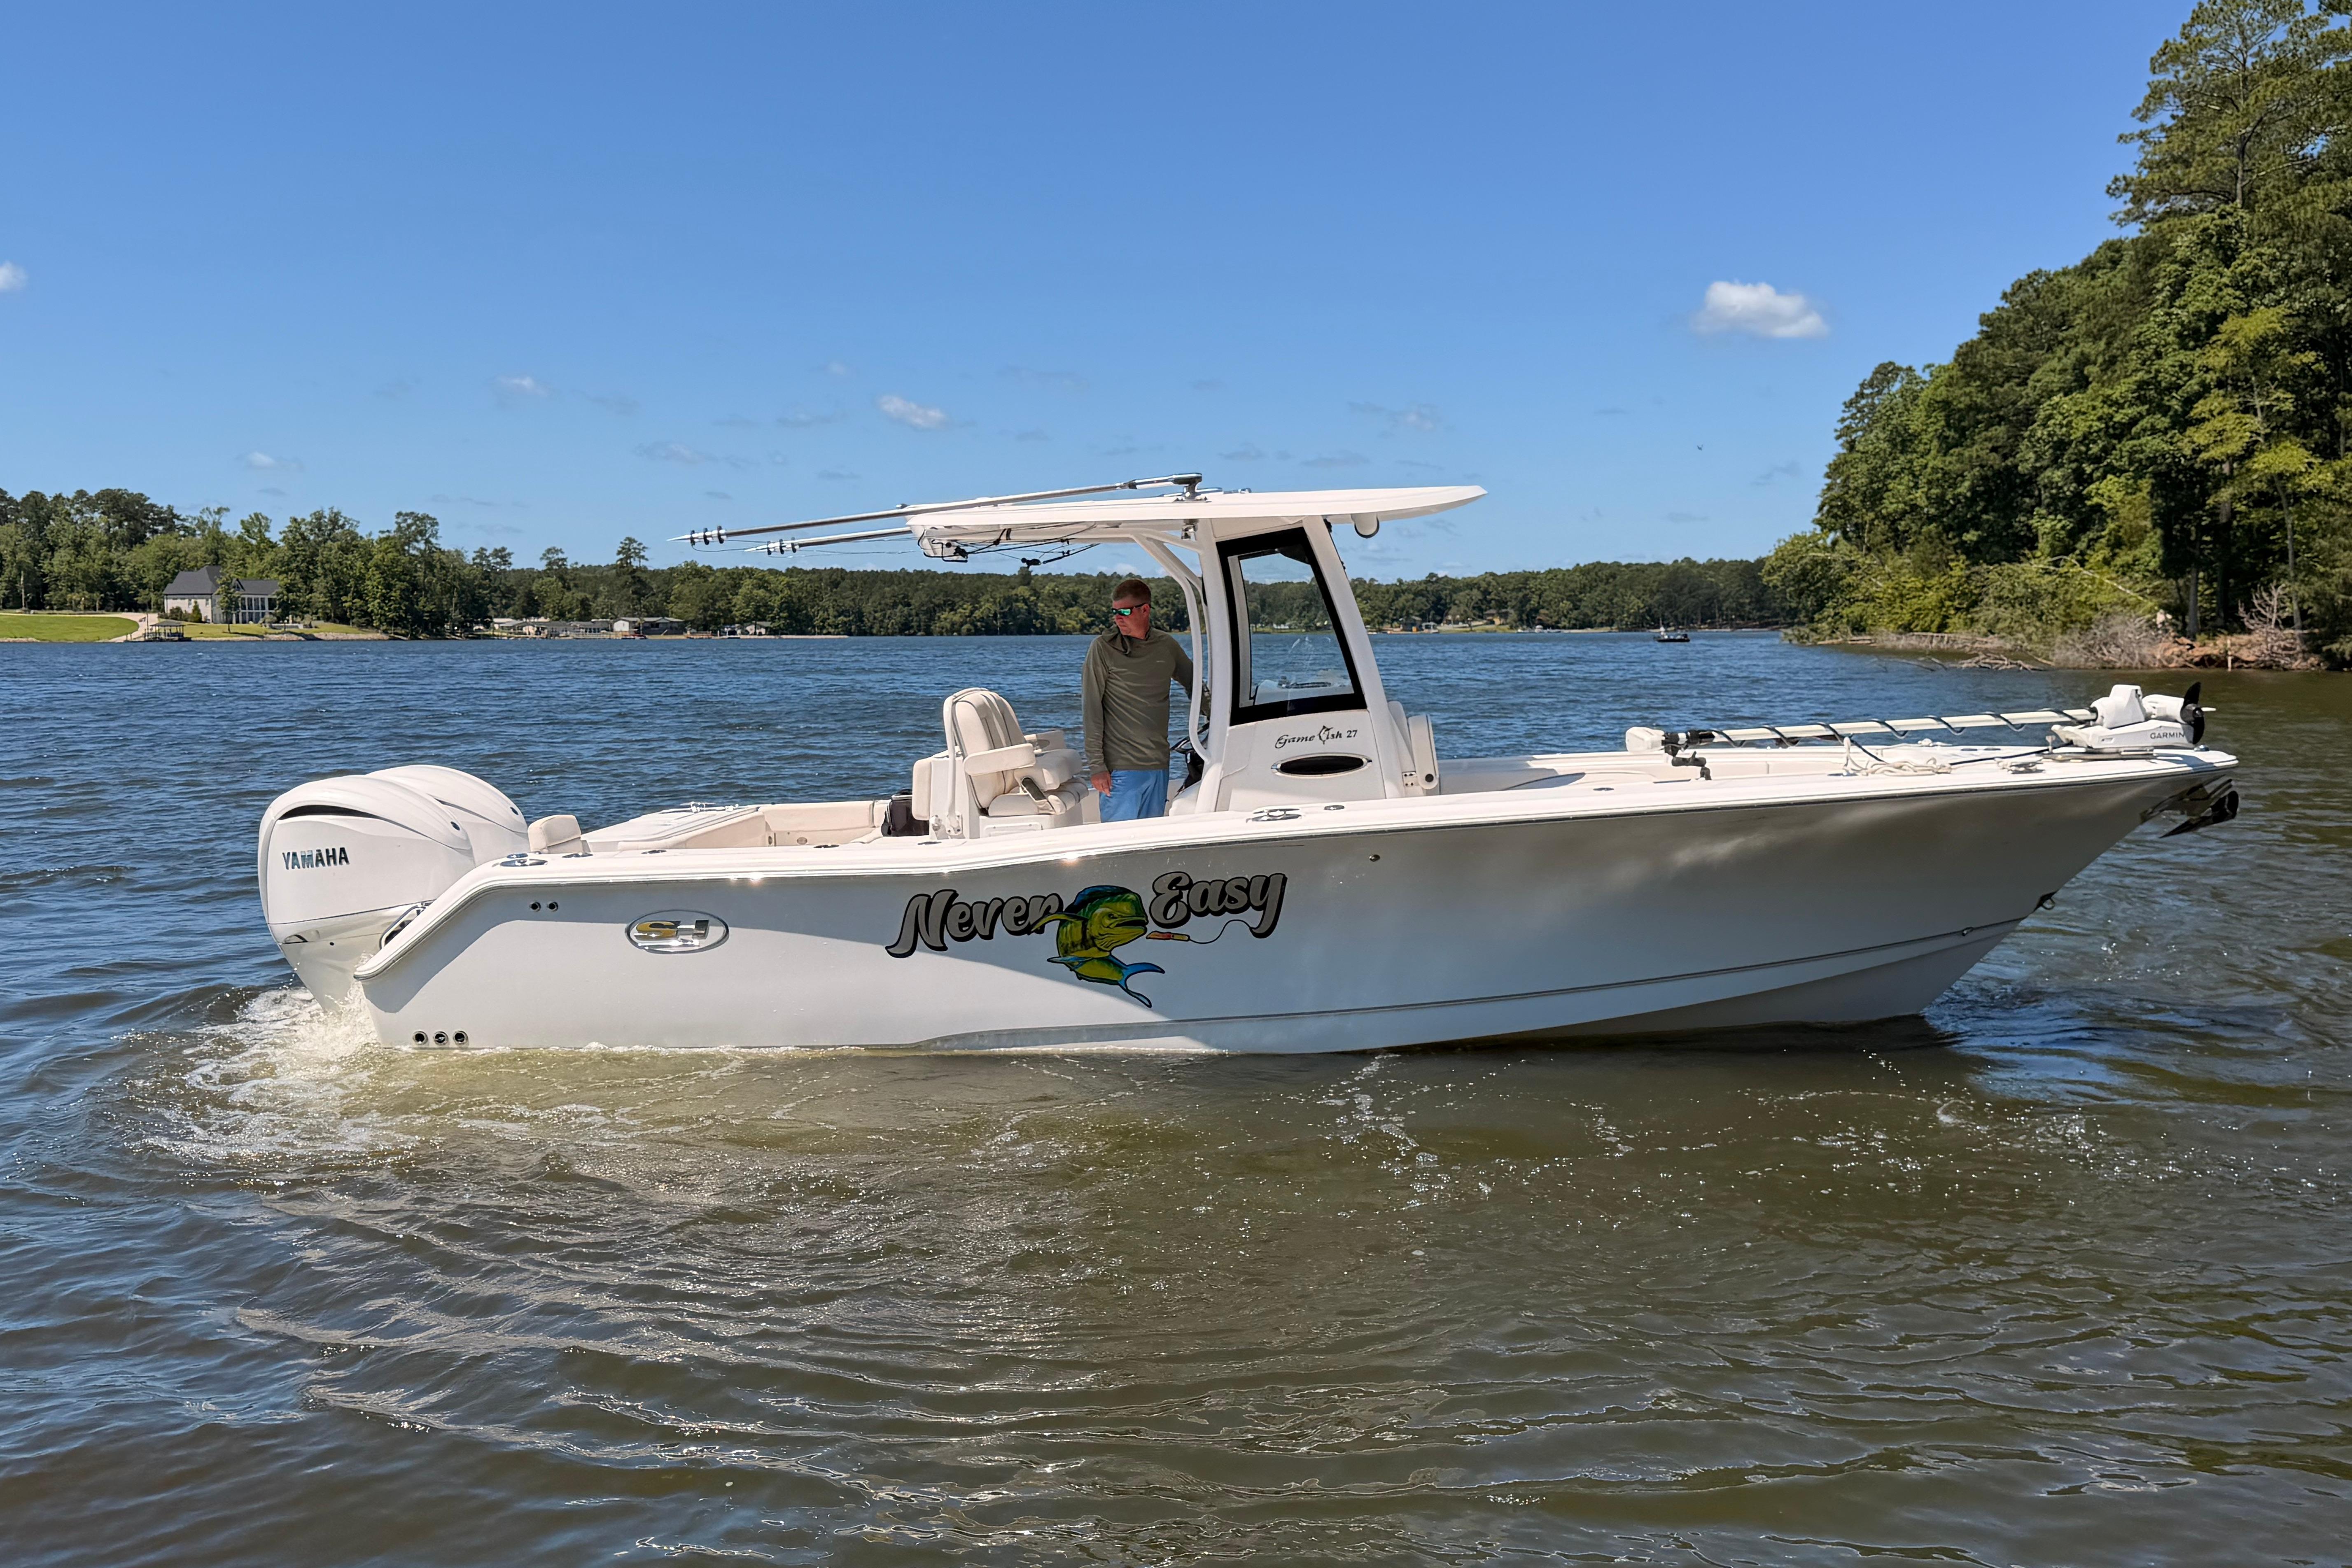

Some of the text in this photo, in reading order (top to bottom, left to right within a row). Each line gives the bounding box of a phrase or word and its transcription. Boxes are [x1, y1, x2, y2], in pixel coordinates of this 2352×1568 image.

[1275, 734, 1315, 749] Game
[1346, 730, 1358, 738] 27
[2150, 731, 2185, 740] GARMIN
[282, 847, 350, 870] YAMAHA
[885, 871, 1288, 958] Never Easy
